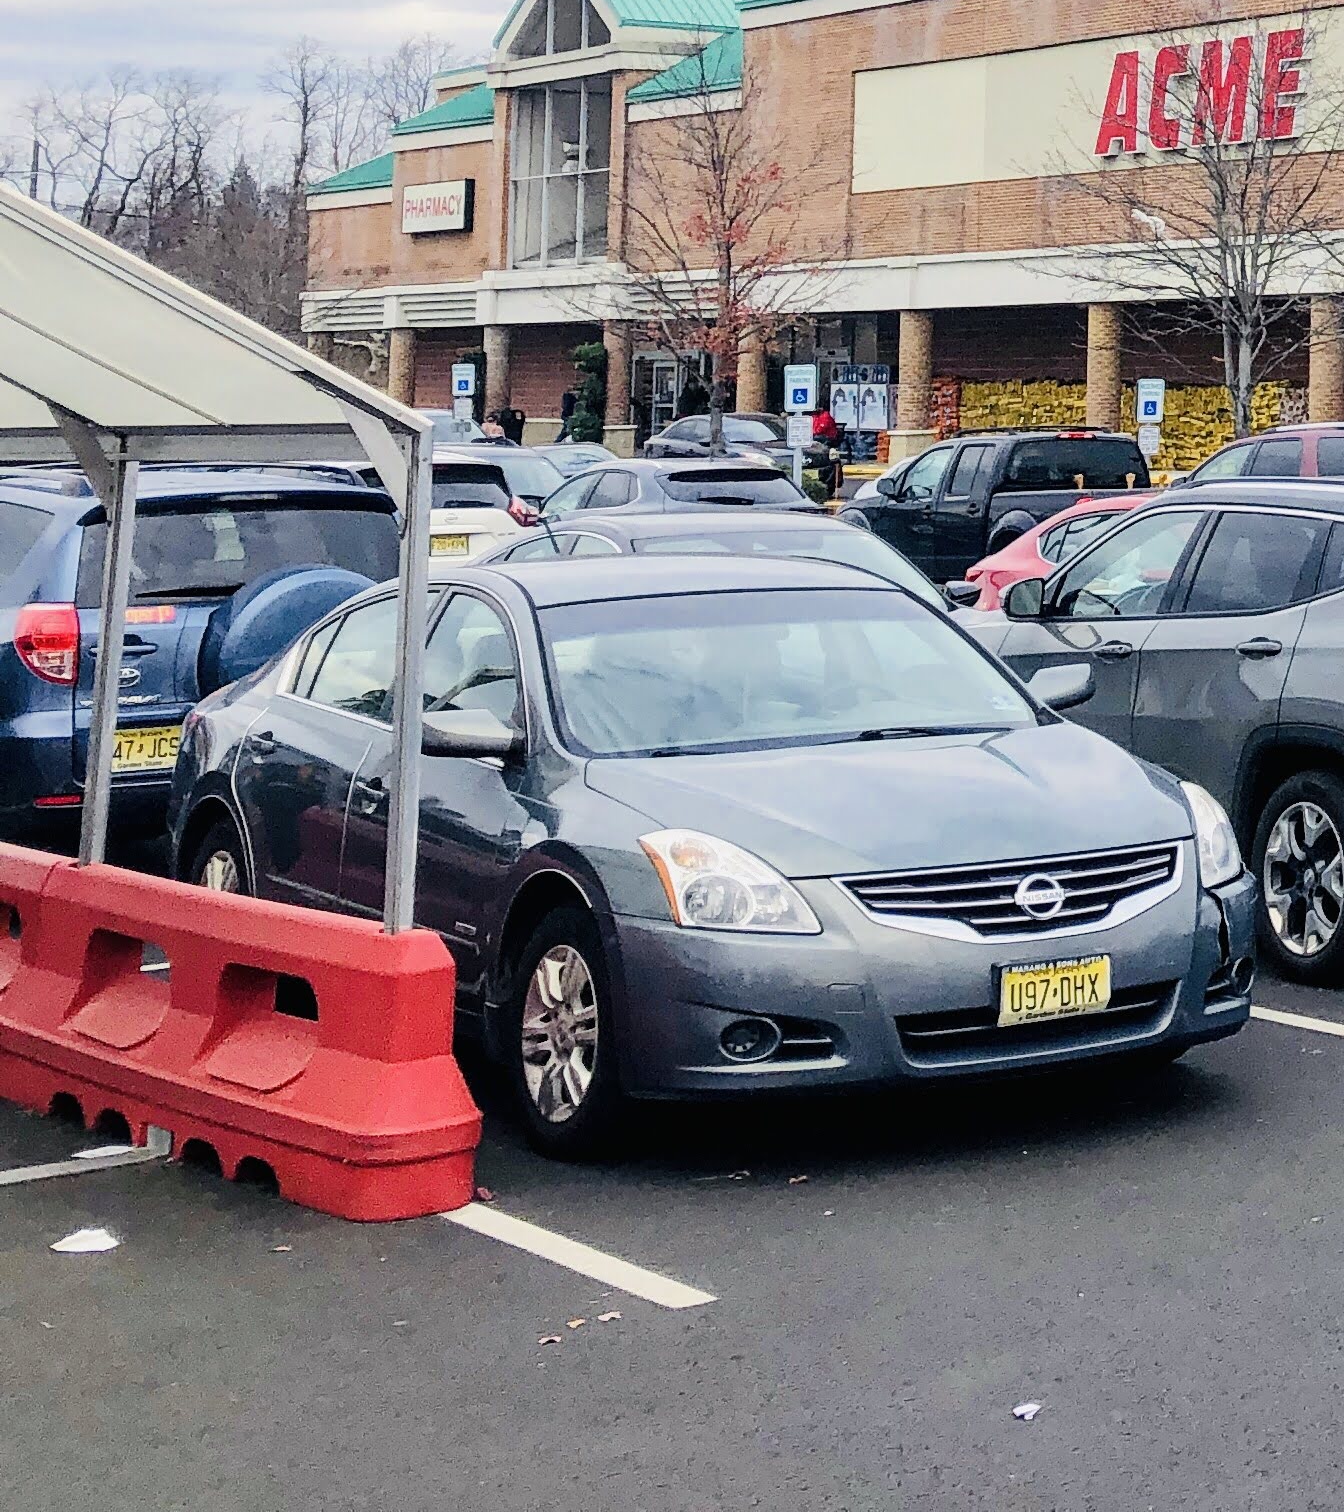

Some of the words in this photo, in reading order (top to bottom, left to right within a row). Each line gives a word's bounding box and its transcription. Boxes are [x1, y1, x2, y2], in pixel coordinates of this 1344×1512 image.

[1094, 27, 1306, 156] ACME
[404, 194, 463, 219] PHARMACY
[1022, 891, 1063, 903] NISSAN
